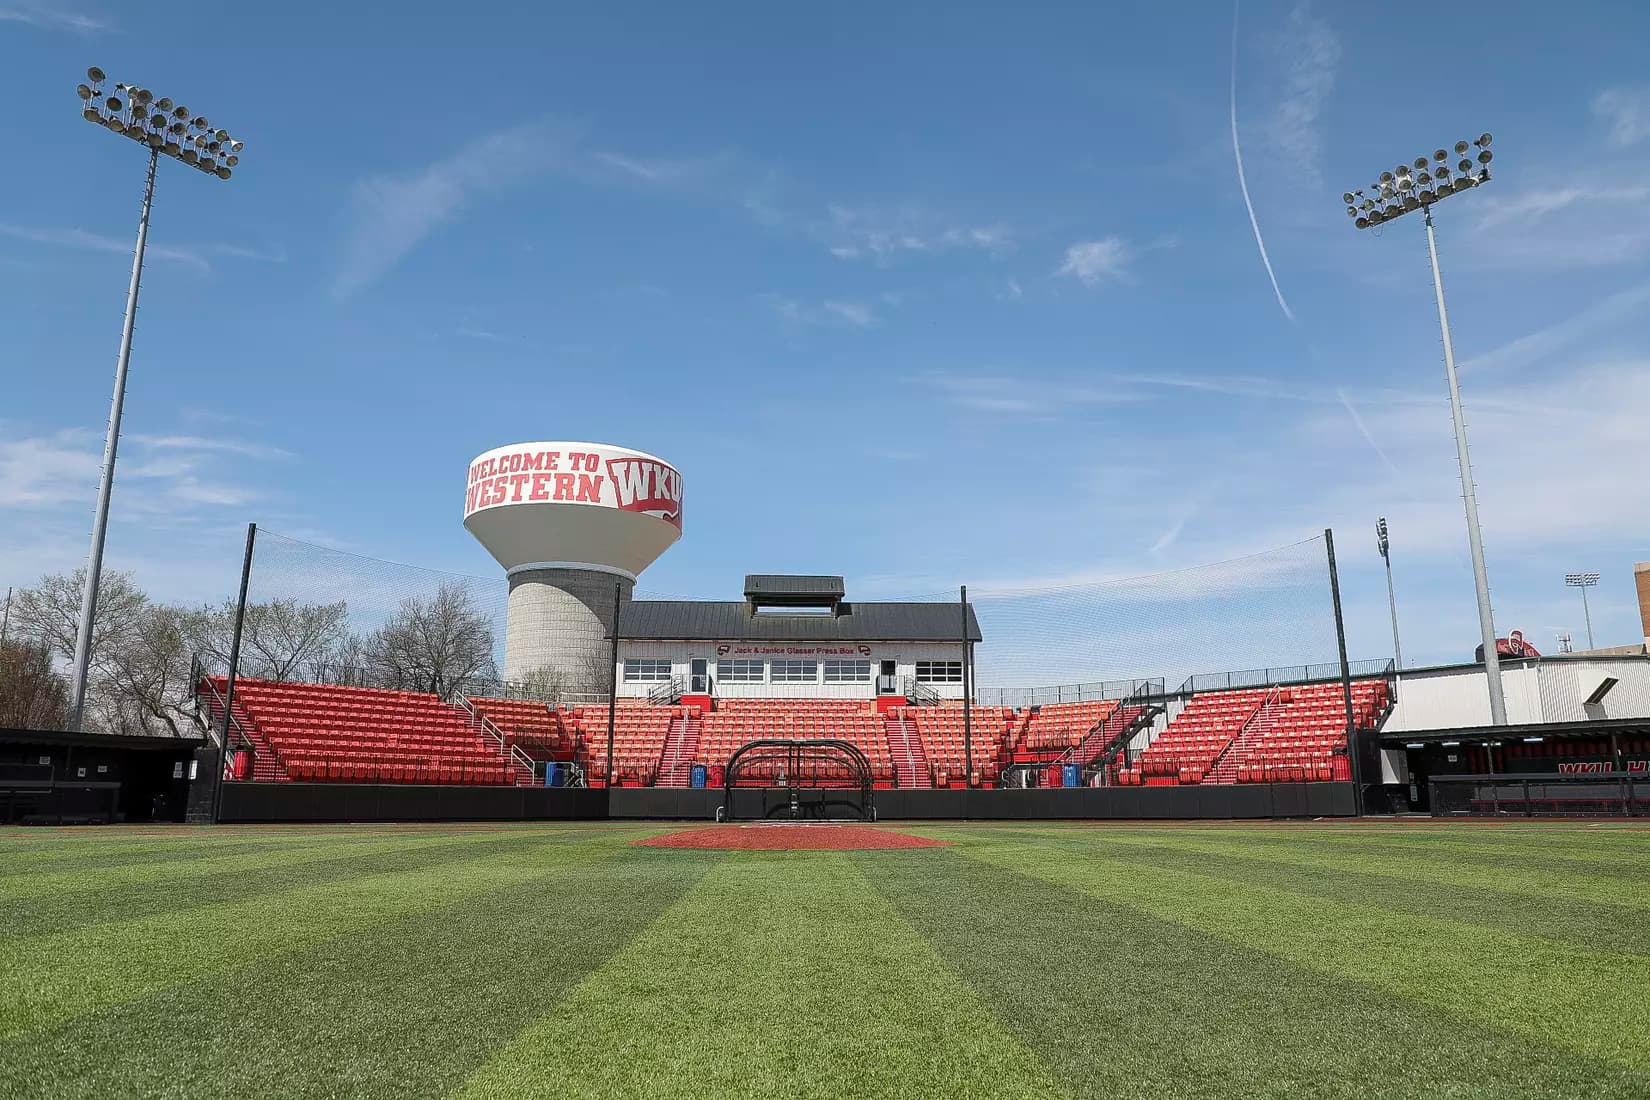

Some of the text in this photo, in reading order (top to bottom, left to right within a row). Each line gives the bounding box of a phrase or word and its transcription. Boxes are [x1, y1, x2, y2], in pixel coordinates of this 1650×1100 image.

[468, 452, 600, 484] WELCOME TO
[611, 461, 681, 506] WKU
[466, 473, 604, 514] WESTERN
